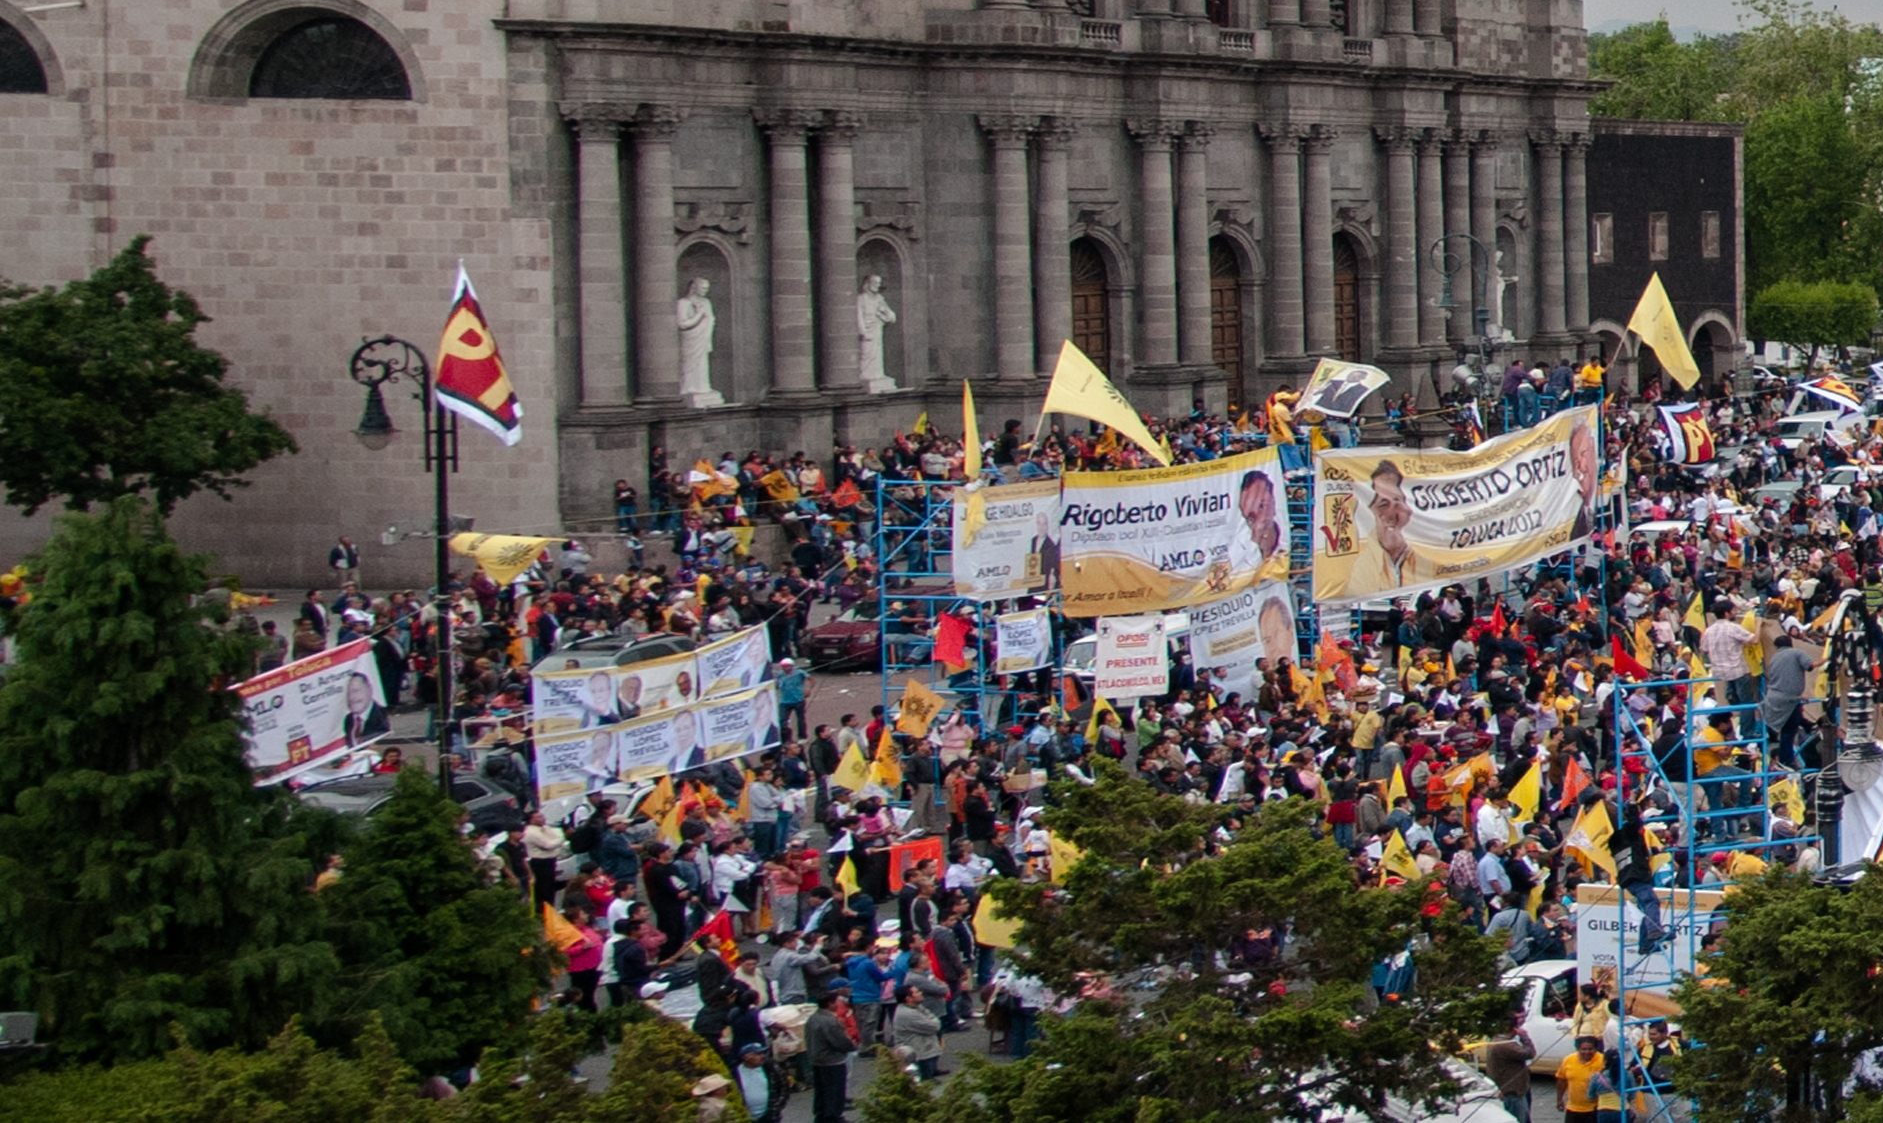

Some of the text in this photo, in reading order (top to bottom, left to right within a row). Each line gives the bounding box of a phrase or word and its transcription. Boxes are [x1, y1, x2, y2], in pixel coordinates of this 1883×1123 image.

[1410, 468, 1511, 512] GILBERTO
[960, 501, 1034, 521] JGE HIDALGO
[1060, 501, 1167, 531] Rigoberto
[1174, 491, 1231, 519] Vivian
[1450, 509, 1543, 549] TOLUCA 2012
[976, 564, 1011, 578] AMLO
[1159, 549, 1206, 572] AMLO
[1190, 593, 1254, 625] HESIQUIO
[1219, 609, 1257, 629] TREVILLA
[287, 656, 333, 679] Toluca
[1106, 656, 1159, 669] PRESENTE
[628, 741, 670, 757] TREVILLA
[1592, 953, 1617, 962] VOTA
